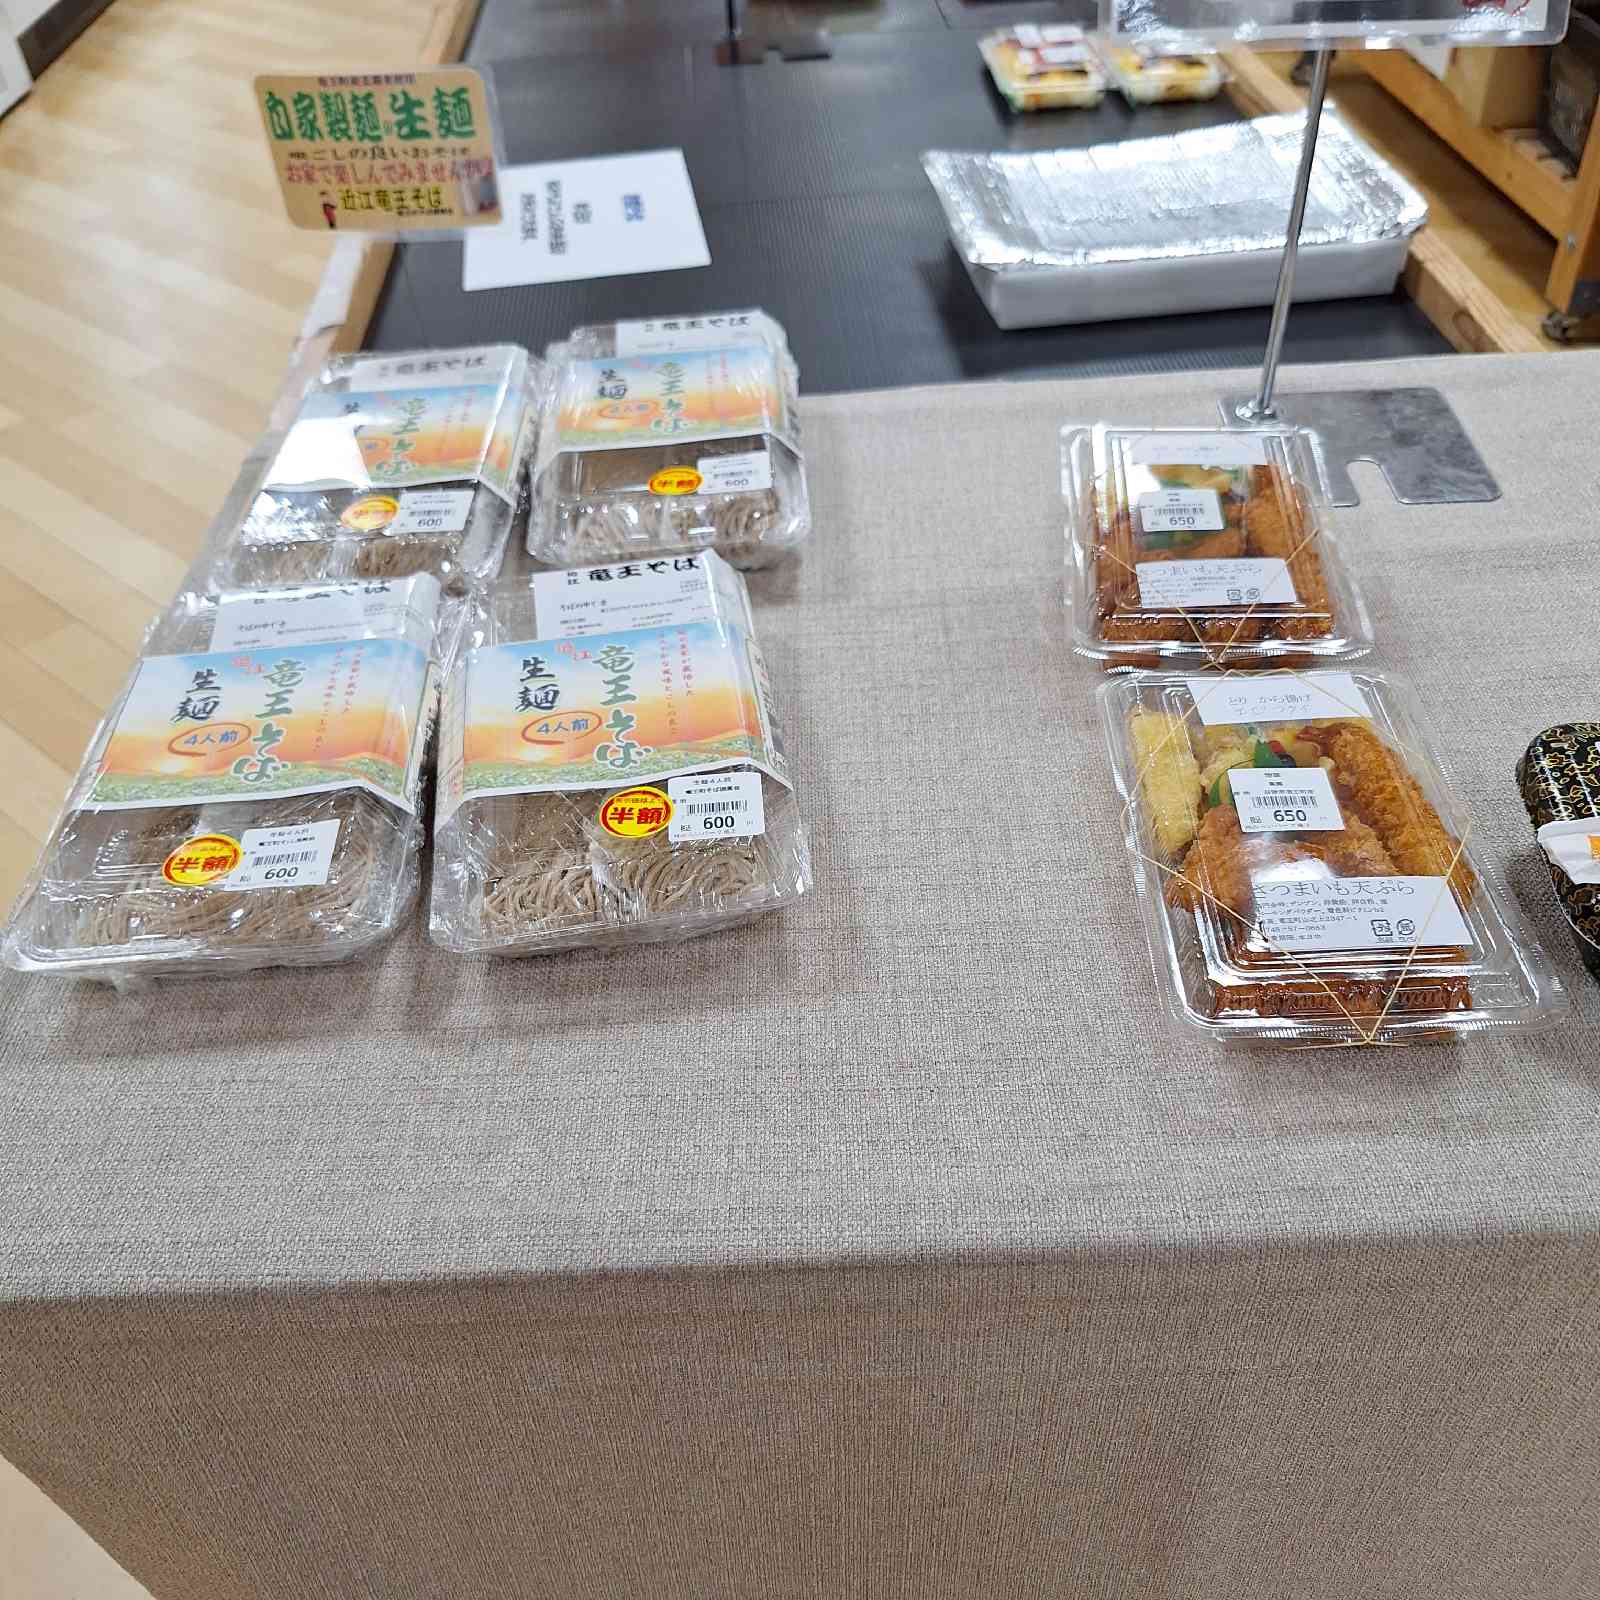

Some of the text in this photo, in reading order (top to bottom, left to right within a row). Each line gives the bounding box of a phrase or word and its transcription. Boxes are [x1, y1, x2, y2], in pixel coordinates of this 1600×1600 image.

[724, 479, 749, 487] 600
[416, 516, 443, 528] 600
[1169, 516, 1195, 526] 650
[513, 655, 561, 713] 生麺
[169, 667, 223, 727] 生麺
[593, 645, 653, 769] 竜王そば
[232, 658, 307, 784] 竜王そば
[536, 717, 591, 735] 4人前
[184, 729, 239, 747] 4人前
[609, 806, 664, 825] 半額
[703, 815, 735, 829] 600
[1273, 809, 1307, 823] 650
[172, 854, 232, 874] 半額
[264, 866, 299, 881] 600
